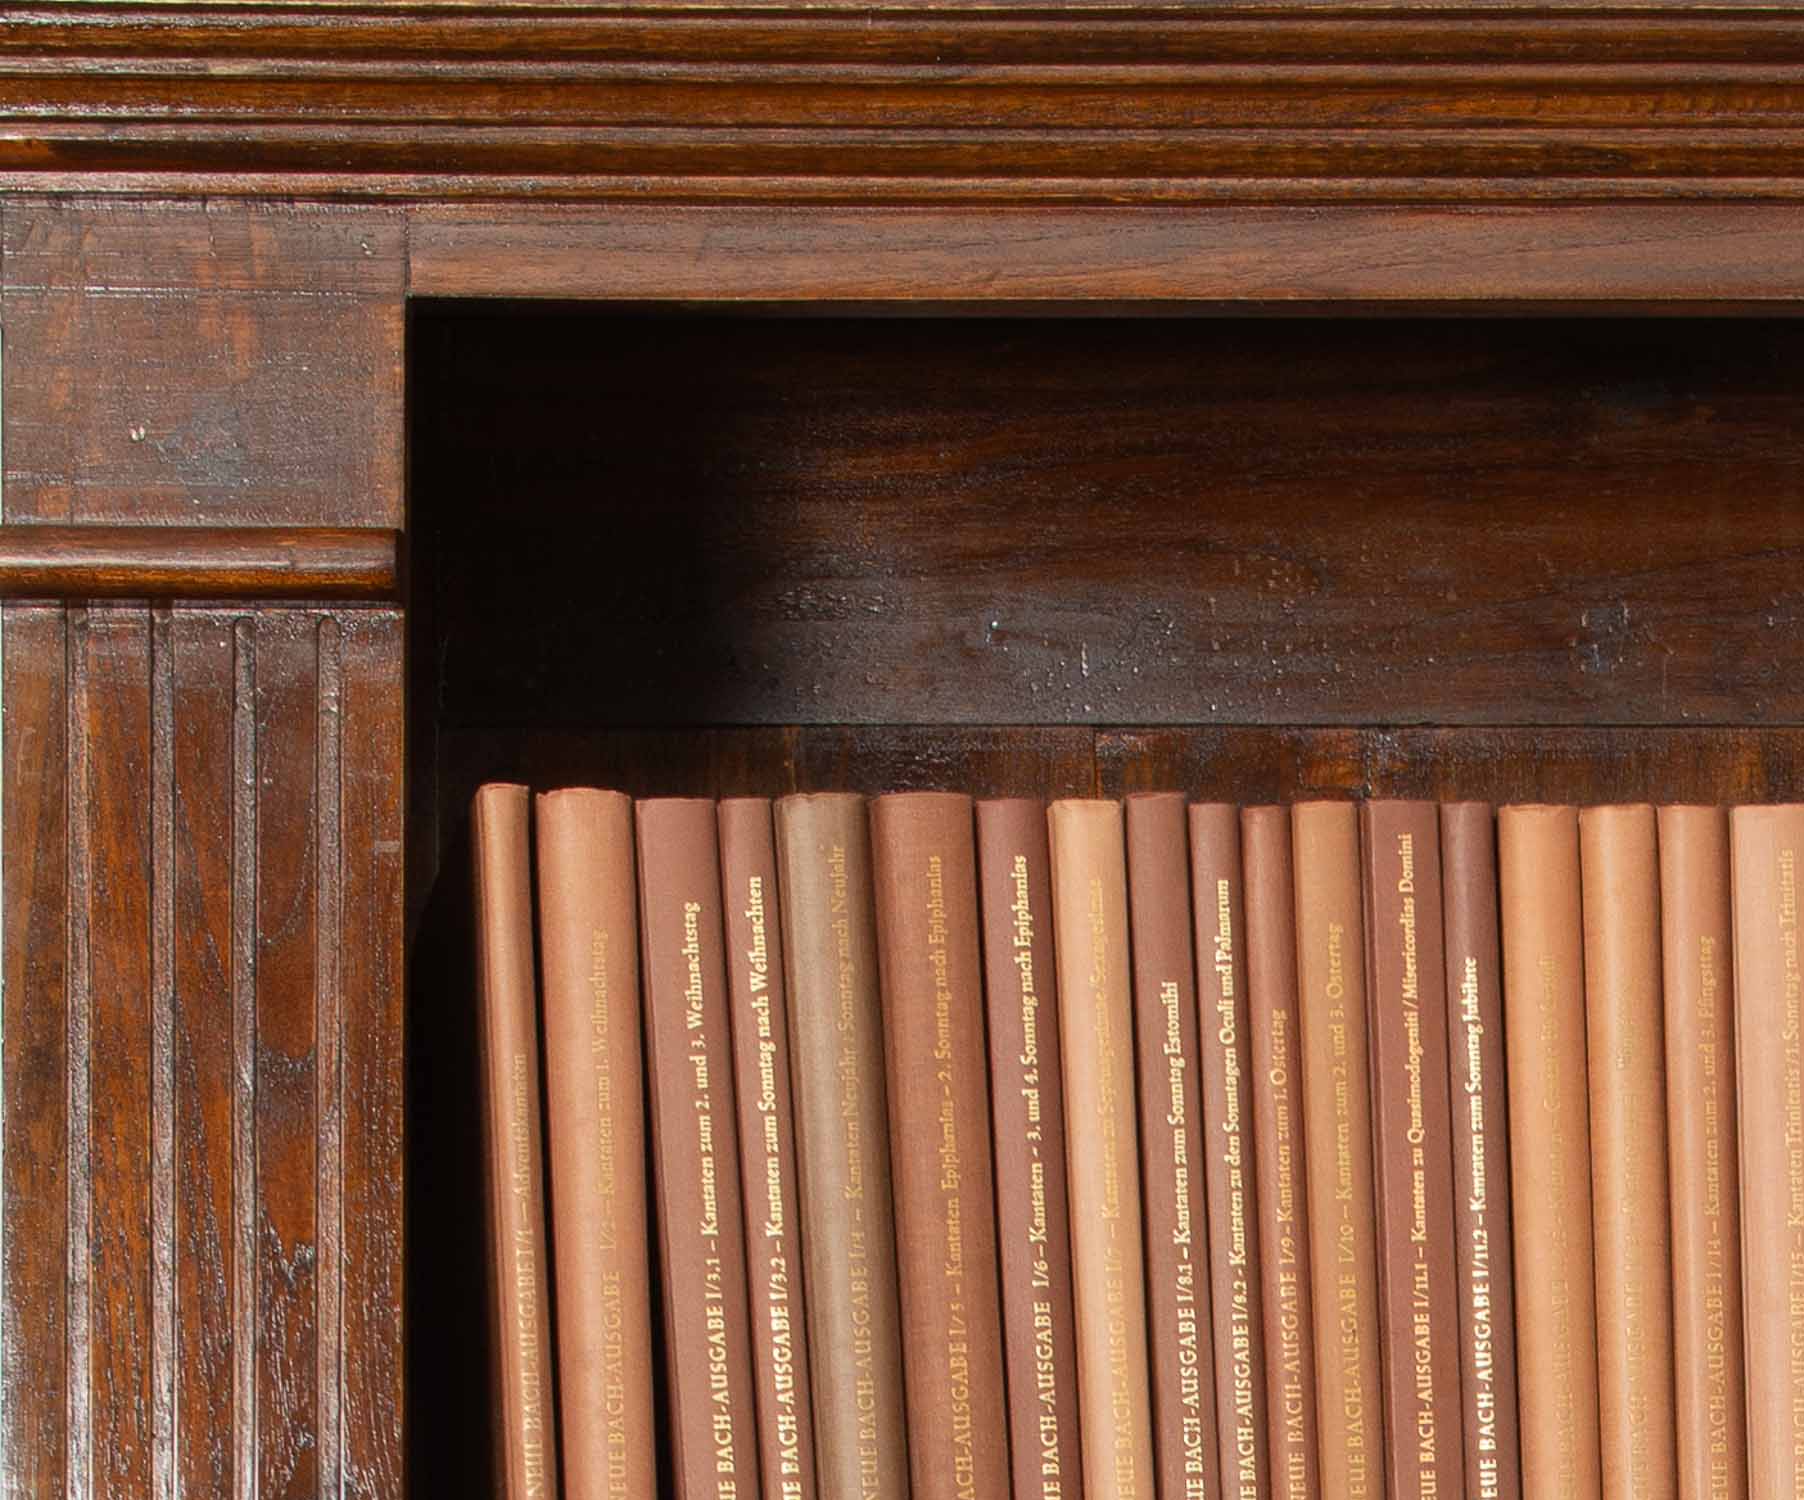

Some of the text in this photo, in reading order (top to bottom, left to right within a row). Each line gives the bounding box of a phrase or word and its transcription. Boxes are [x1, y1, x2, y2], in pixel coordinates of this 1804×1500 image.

[681, 901, 703, 1029] Weihnachtstag
[744, 875, 768, 992] Weihnachten
[690, 1033, 706, 1048] 3.
[750, 994, 771, 1037] nach
[1159, 980, 1181, 1054] Estomihi
[688, 1054, 709, 1089] und
[694, 1093, 710, 1109] 2.
[756, 1040, 777, 1111] Sonntag
[1166, 1055, 1186, 1125] Sonntag
[698, 1114, 713, 1152] zum
[763, 1114, 779, 1152] zum
[1173, 1127, 1187, 1164] zum
[699, 1155, 719, 1235] Kantaten
[764, 1156, 784, 1237] Kantaten
[1172, 1166, 1191, 1244] Kantaten
[704, 1257, 723, 1299] I/3.1
[768, 1256, 788, 1300] I/3.2
[1175, 1262, 1194, 1302] I/8.1
[705, 1305, 735, 1473] BACH-AUSGABE
[769, 1305, 800, 1474] BACH-AUSGABE
[1177, 1307, 1203, 1473] BACH-AUSGABE
